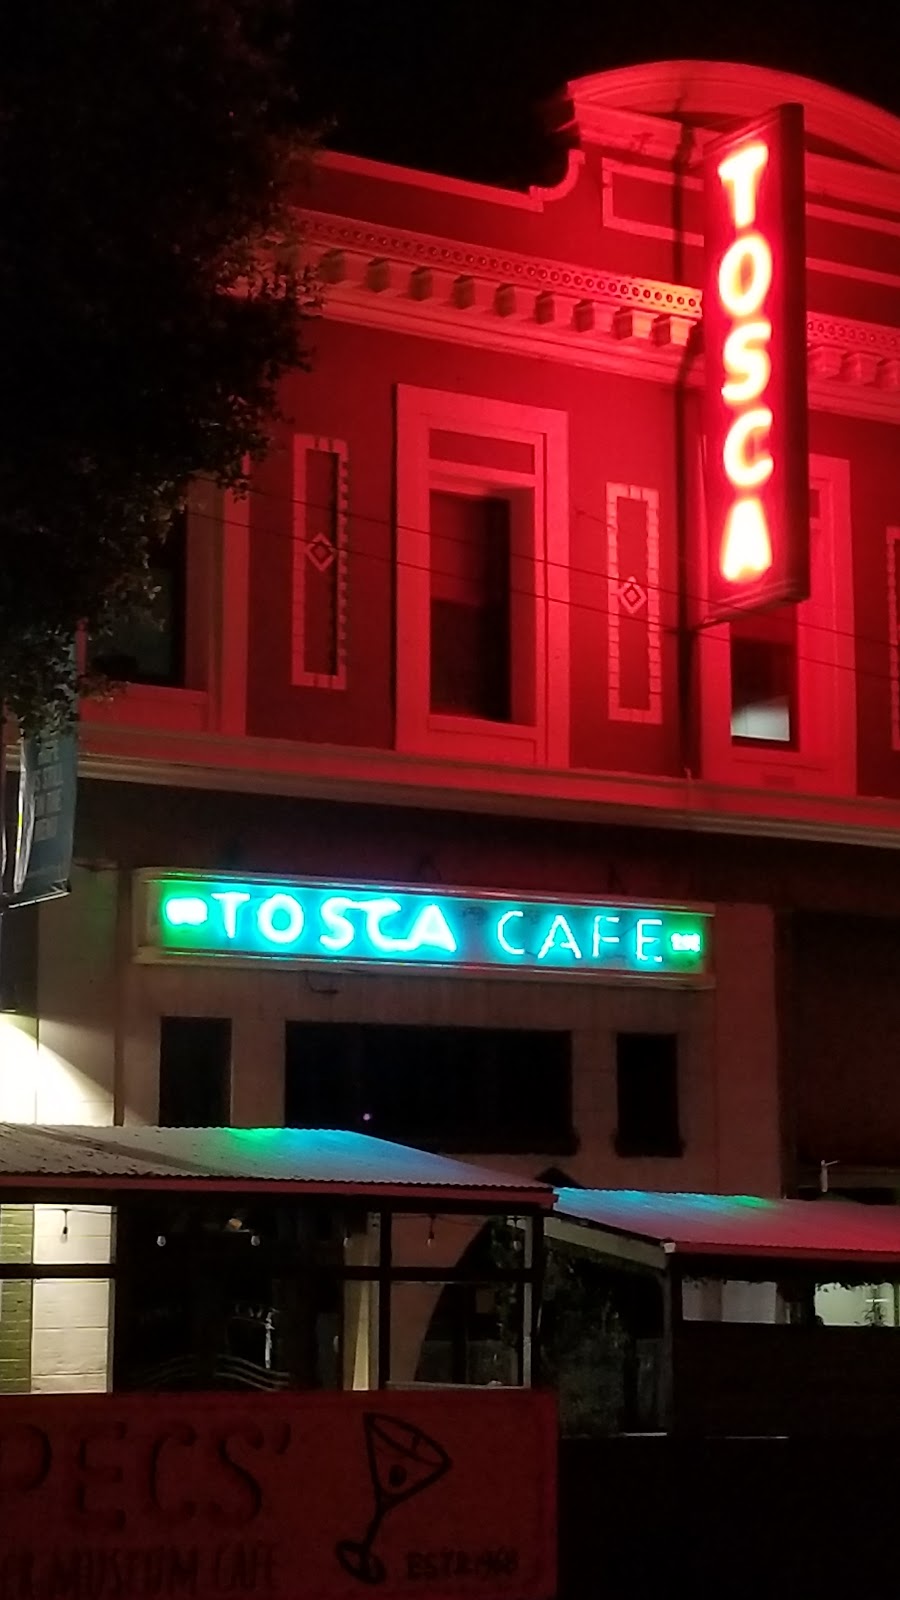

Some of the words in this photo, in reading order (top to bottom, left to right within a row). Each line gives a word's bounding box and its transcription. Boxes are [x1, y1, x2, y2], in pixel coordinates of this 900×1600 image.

[716, 143, 774, 584] TOSCA
[211, 892, 457, 952] TOSCA
[497, 910, 664, 963] CAFE
